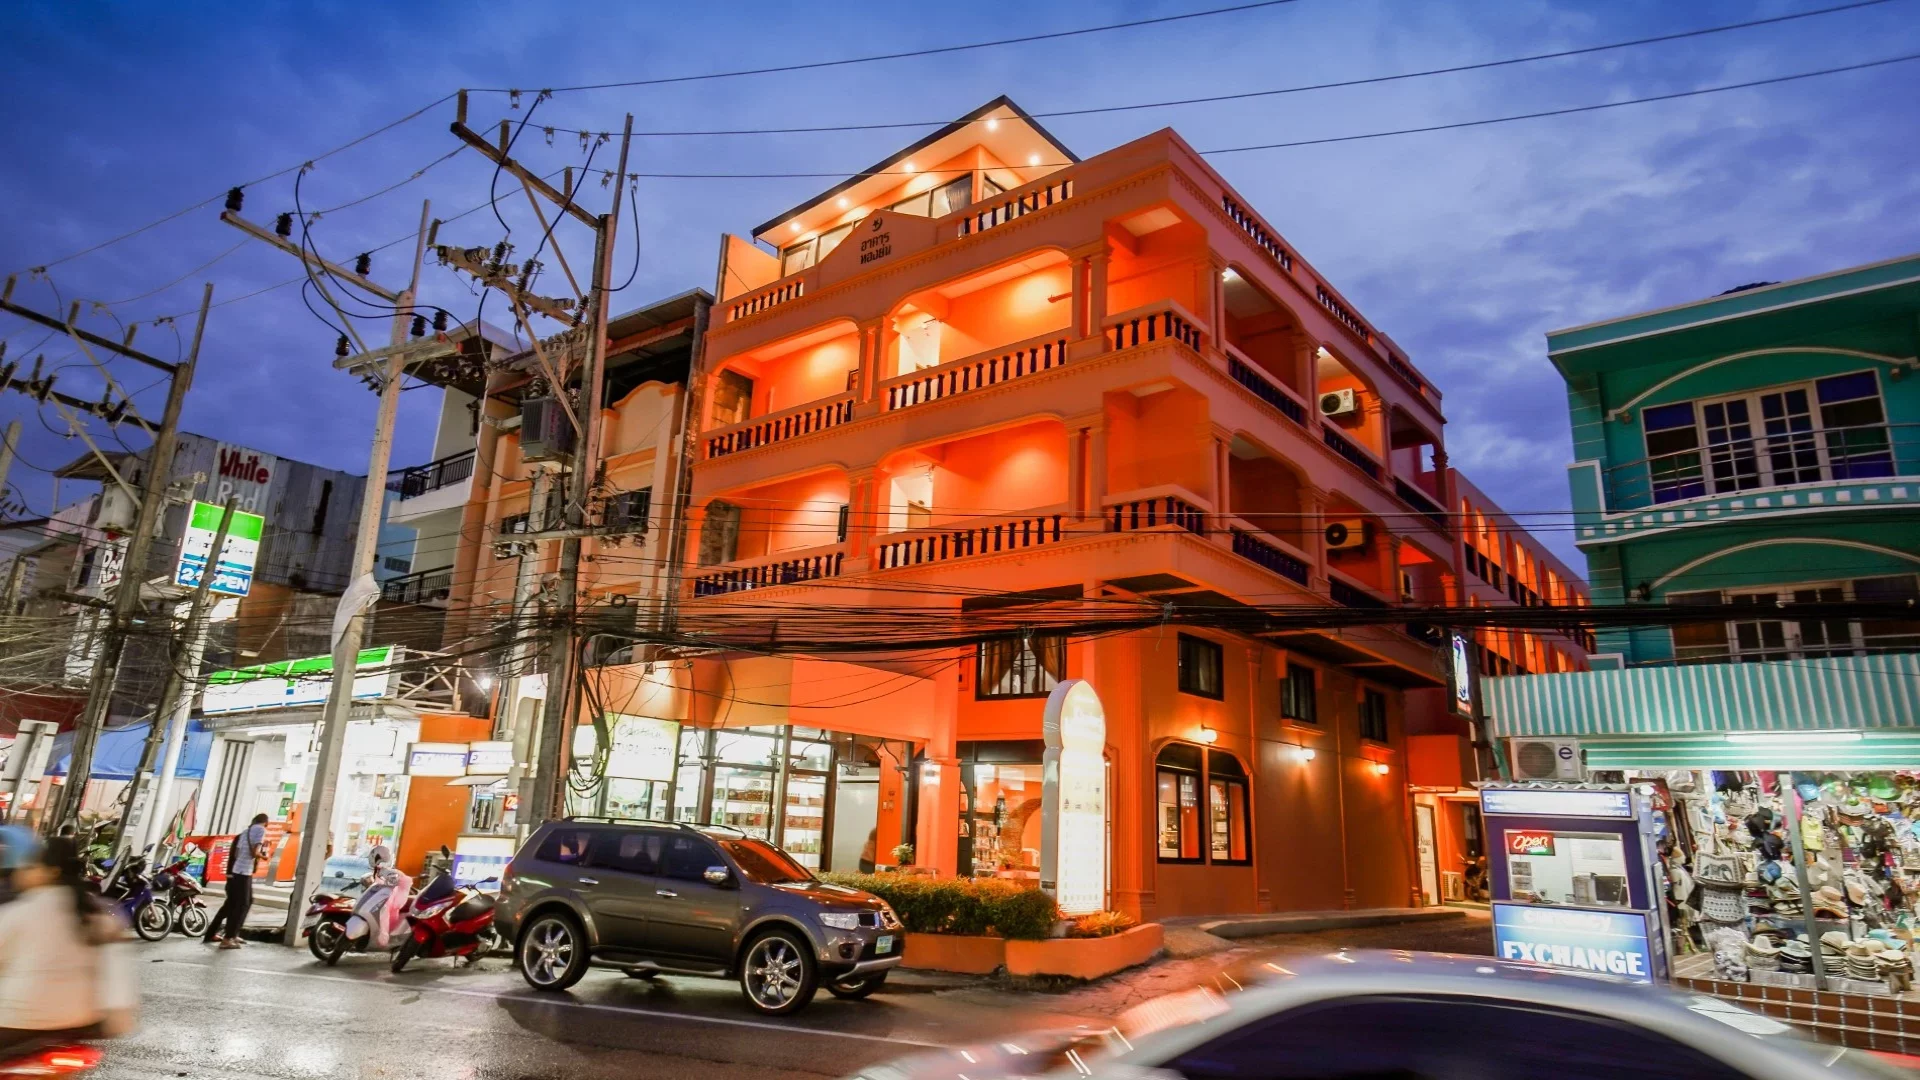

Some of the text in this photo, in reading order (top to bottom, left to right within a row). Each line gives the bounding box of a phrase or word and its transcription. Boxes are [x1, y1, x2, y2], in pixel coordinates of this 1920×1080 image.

[219, 448, 270, 484] White
[216, 481, 260, 511] Red
[1513, 835, 1548, 853] Open
[1503, 941, 1646, 976] EXCHANGE
